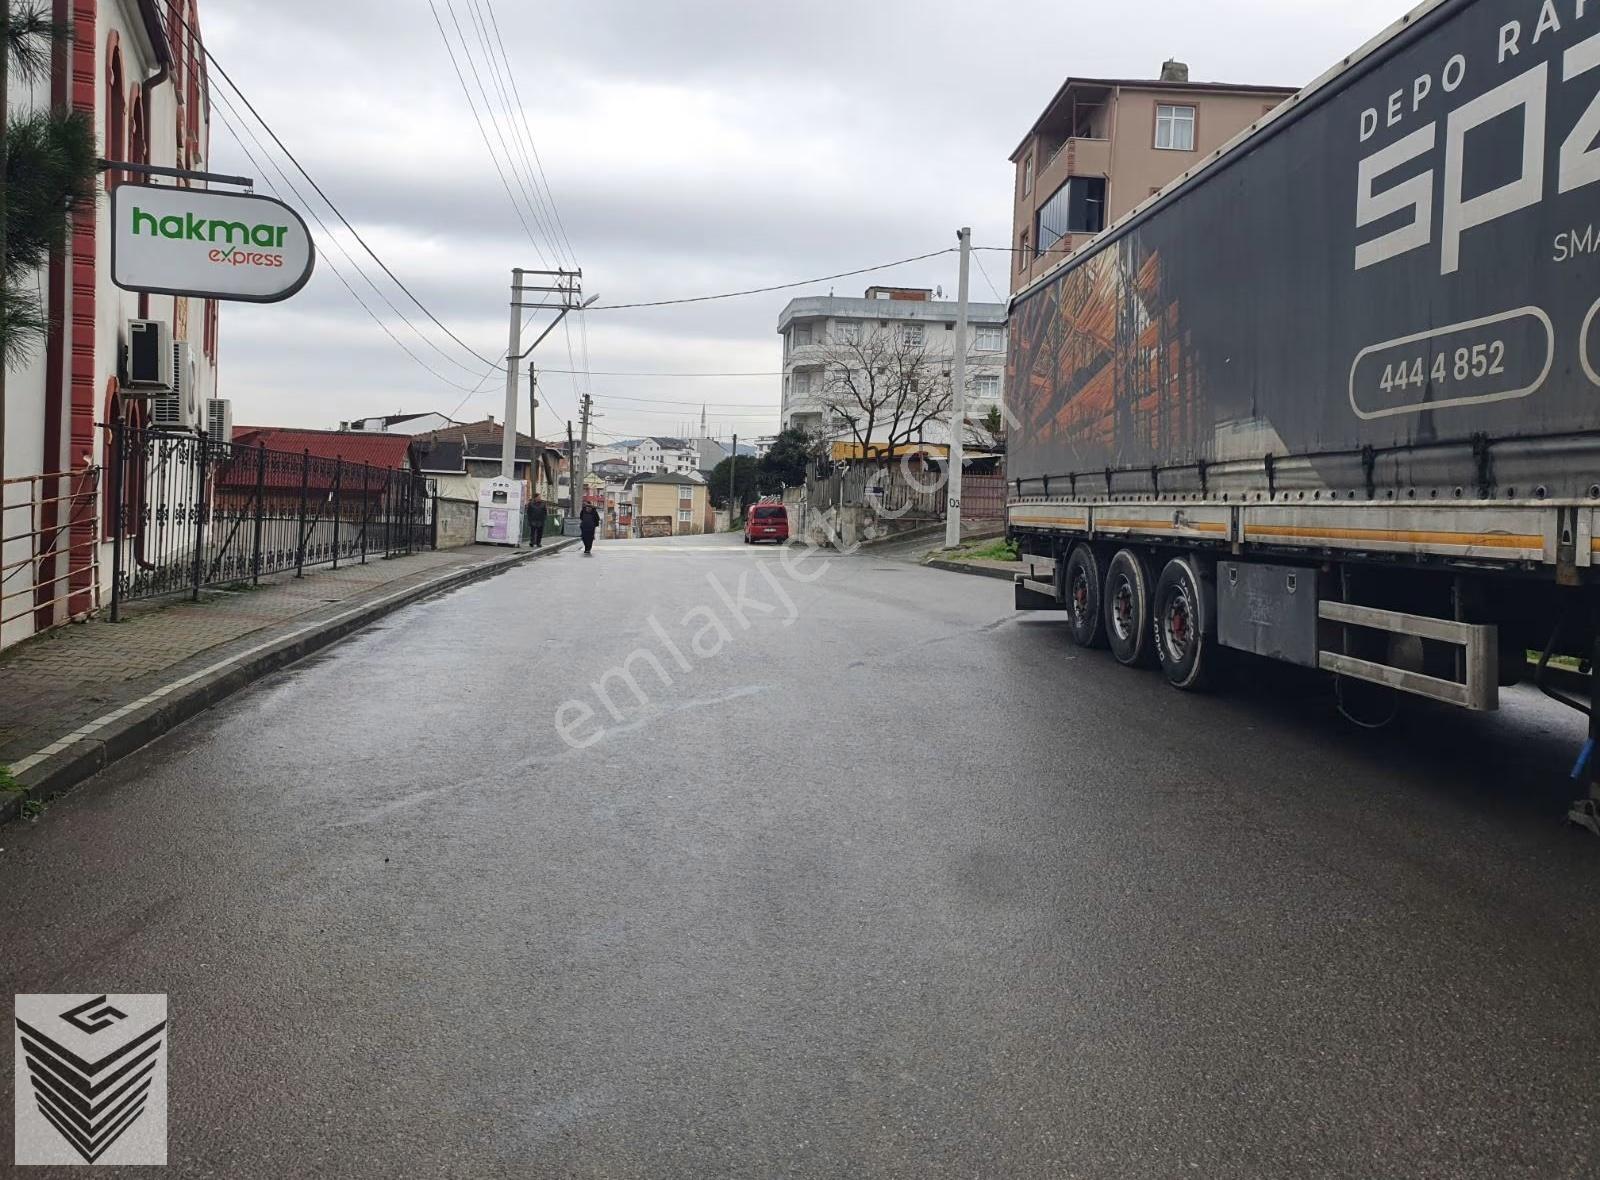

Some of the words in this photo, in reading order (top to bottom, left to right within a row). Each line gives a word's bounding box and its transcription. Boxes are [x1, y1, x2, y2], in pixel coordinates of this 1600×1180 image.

[1359, 53, 1466, 142] DEPO
[132, 206, 288, 247] hakmar
[208, 246, 283, 267] express
[1380, 357, 1424, 392] 444
[1431, 352, 1446, 383] 4
[1453, 340, 1505, 380] 852
